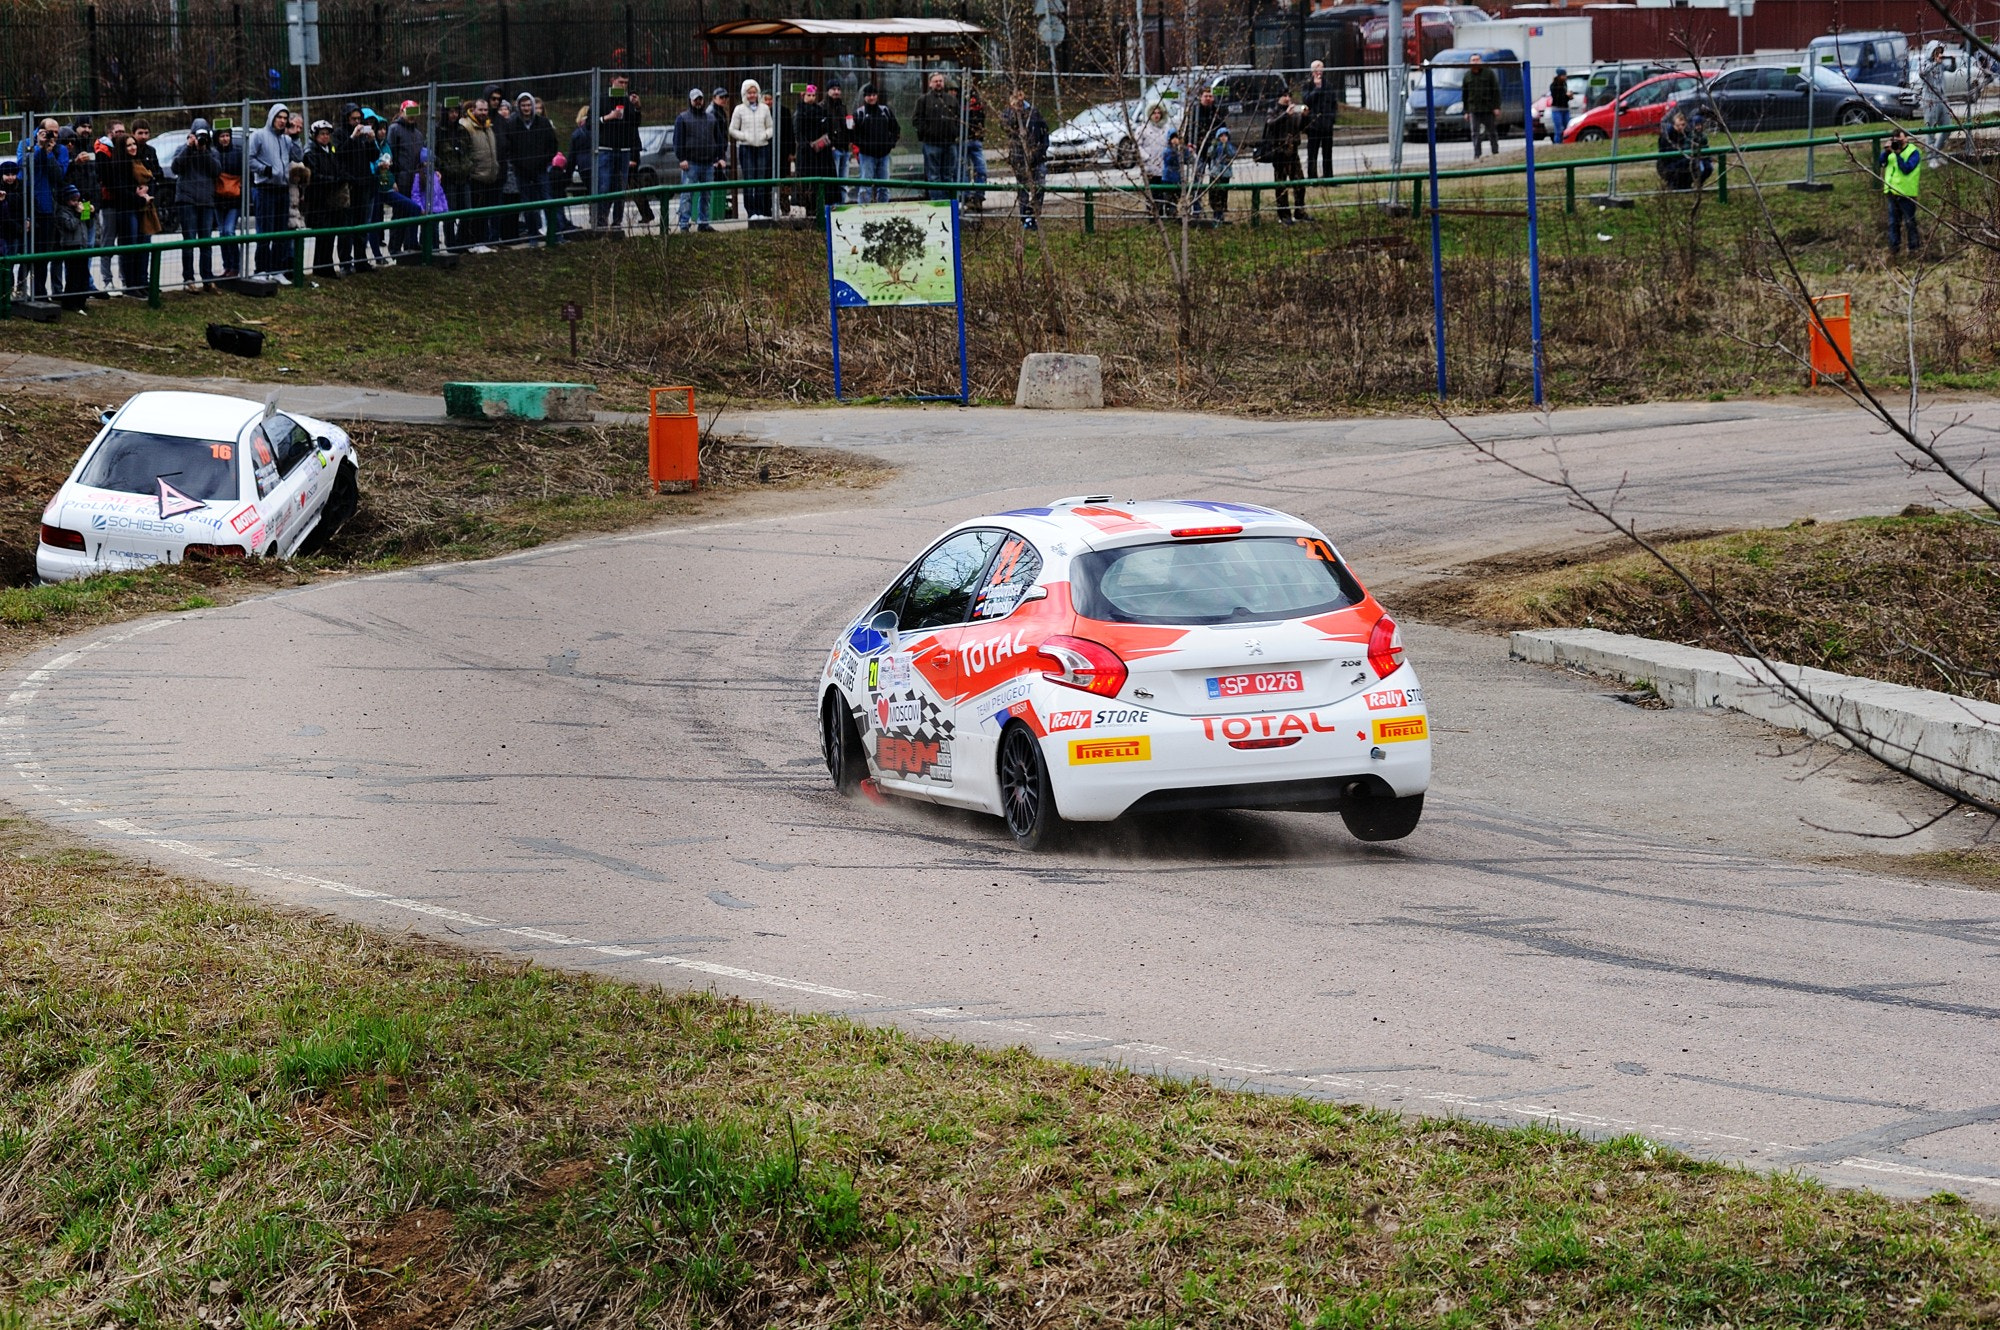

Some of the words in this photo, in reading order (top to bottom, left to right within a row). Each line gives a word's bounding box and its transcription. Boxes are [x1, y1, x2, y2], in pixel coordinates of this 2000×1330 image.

[210, 443, 232, 461] 16
[107, 515, 185, 534] SCHIBERG
[182, 511, 223, 530] Team
[1295, 537, 1336, 562] 21
[991, 540, 1025, 584] 21
[959, 628, 1029, 677] TOTAL
[868, 661, 878, 687] 21
[1225, 677, 1249, 695] SP
[1256, 673, 1298, 692] 0276
[976, 701, 991, 717] TEAM
[990, 682, 1034, 709] PEUGEOT
[1369, 690, 1403, 707] Rally
[889, 704, 920, 721] MOSCOW
[1011, 702, 1029, 715] RUSSIA
[1051, 711, 1091, 730] Rally
[1094, 710, 1150, 724] STORE
[1190, 712, 1335, 741] TOTAL
[1379, 719, 1424, 738] PIRELLI
[1076, 741, 1140, 760] PIRELLI
